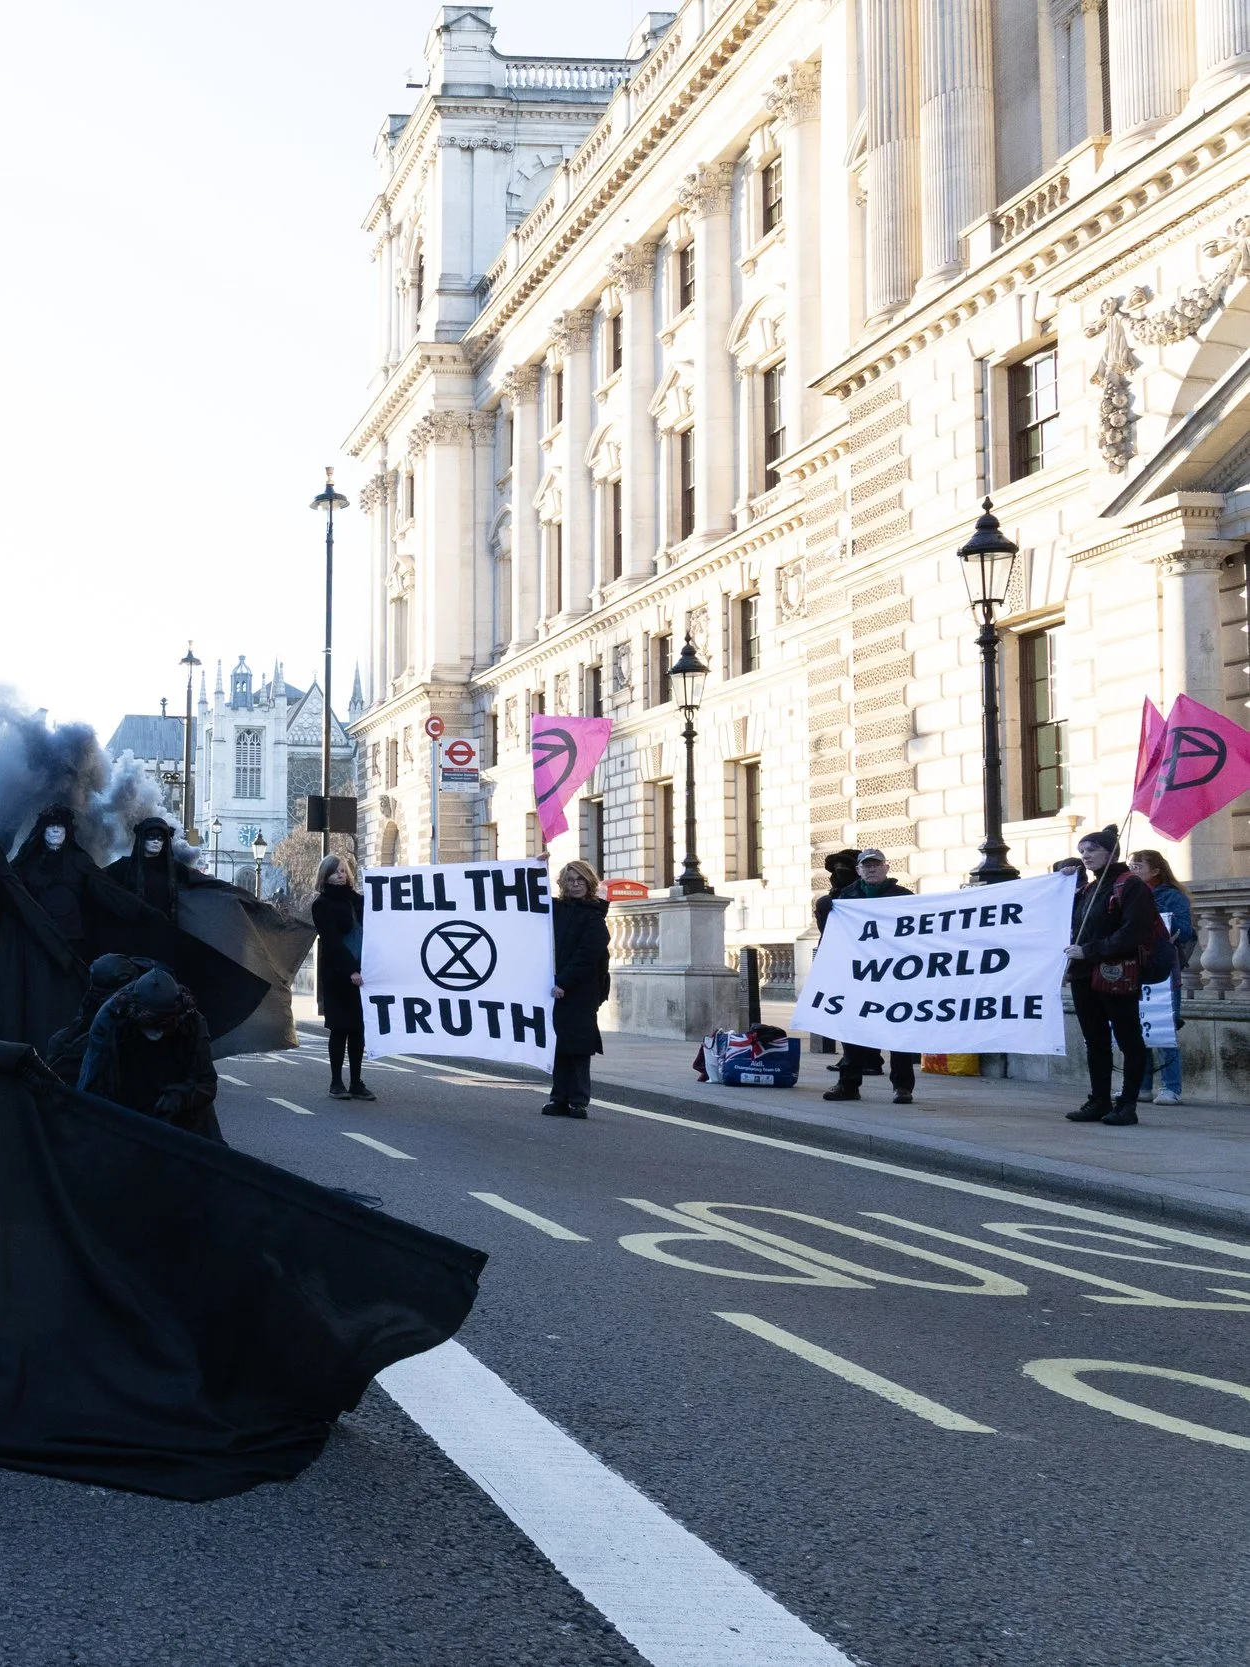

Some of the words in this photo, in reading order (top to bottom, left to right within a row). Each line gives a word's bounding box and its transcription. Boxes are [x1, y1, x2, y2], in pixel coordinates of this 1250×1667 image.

[428, 719, 440, 735] C
[364, 873, 456, 912] TELL
[464, 867, 550, 914] THE
[858, 920, 880, 942] A
[894, 903, 1024, 938] BETTER
[852, 948, 1011, 982] WORLD
[369, 995, 547, 1049] TRUTH
[811, 991, 845, 1015] IS
[858, 995, 1044, 1023] POSSIBLE
